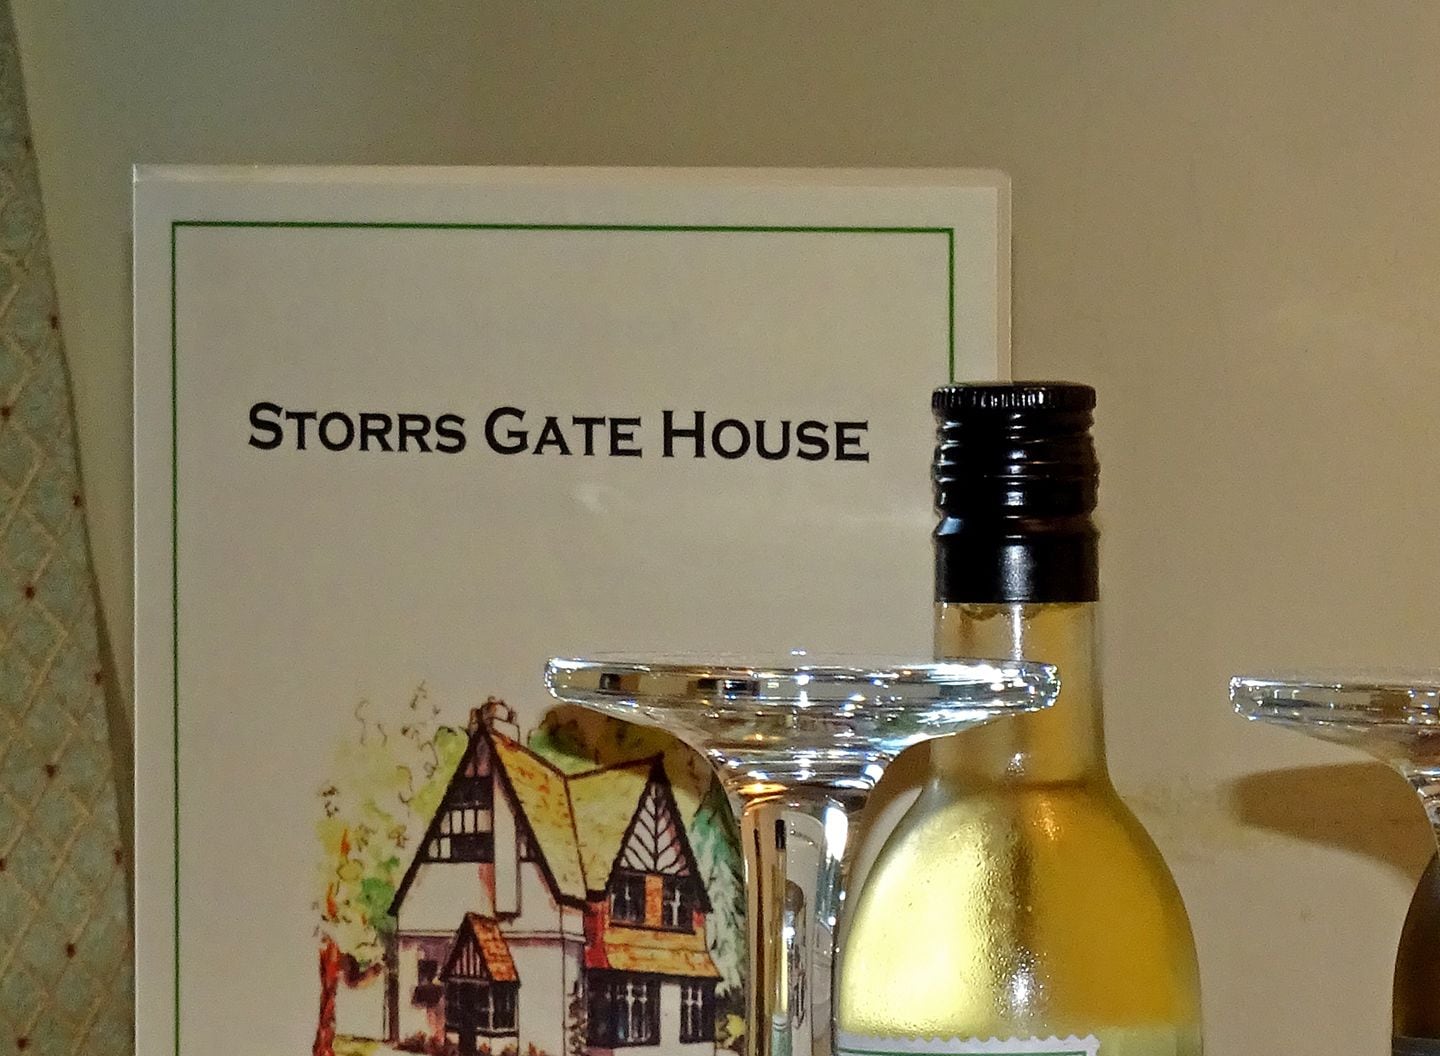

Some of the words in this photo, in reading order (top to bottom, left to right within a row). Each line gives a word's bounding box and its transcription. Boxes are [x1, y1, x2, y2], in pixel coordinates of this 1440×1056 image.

[248, 402, 466, 454] STORRS
[484, 406, 643, 458] GATE
[662, 410, 870, 463] HOUSE
